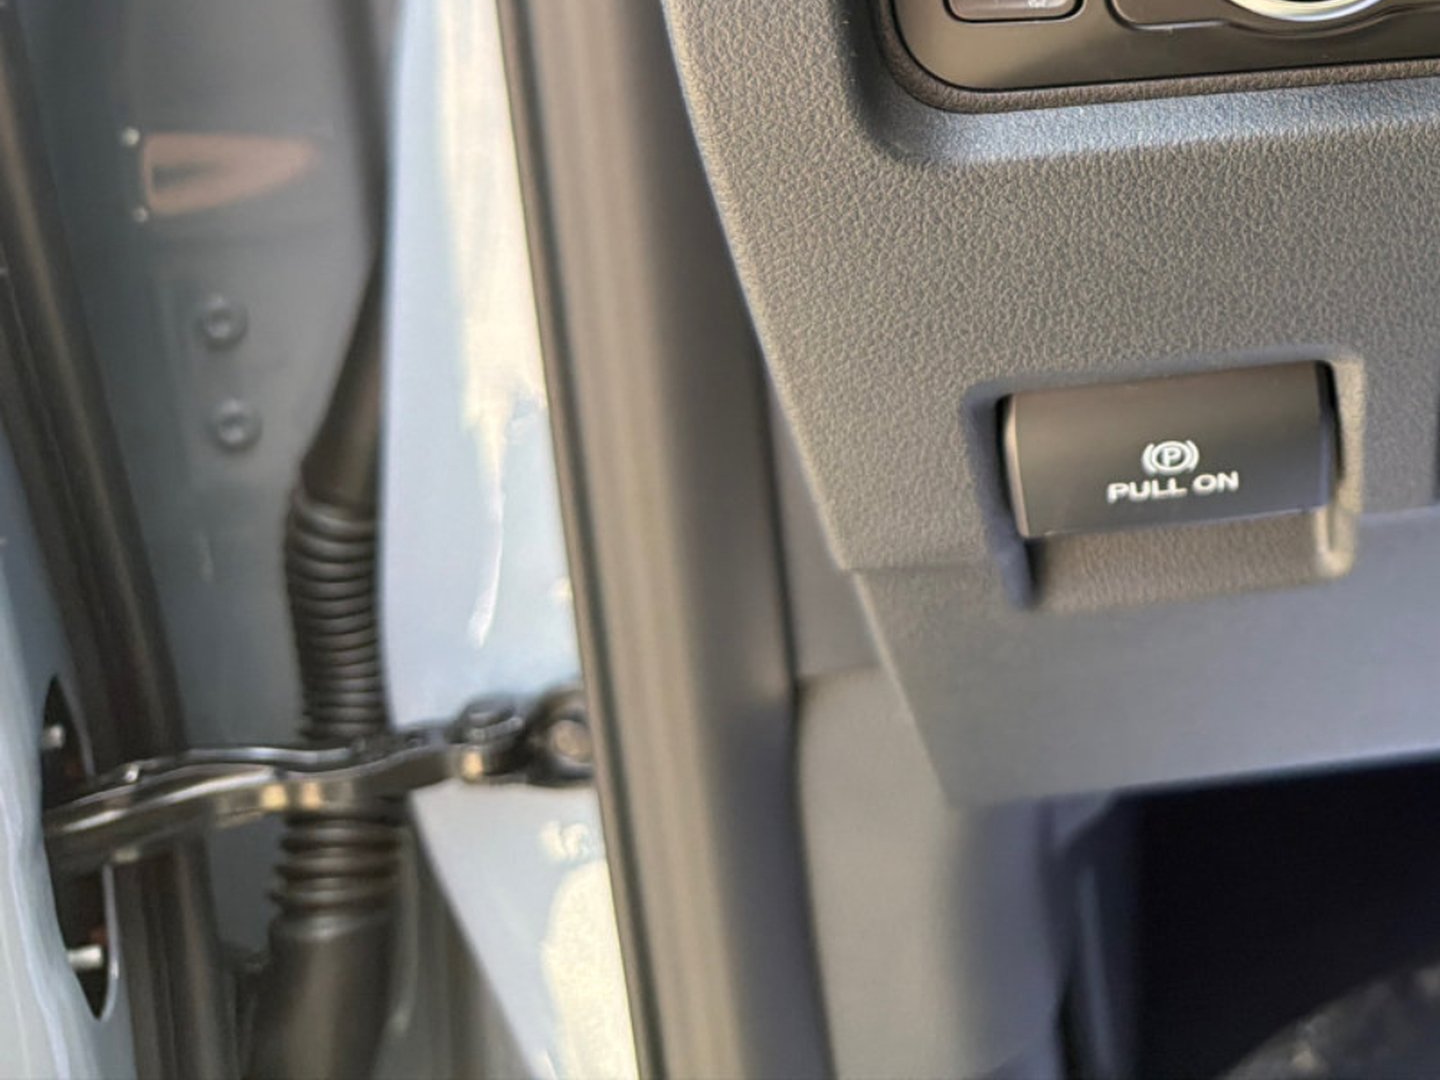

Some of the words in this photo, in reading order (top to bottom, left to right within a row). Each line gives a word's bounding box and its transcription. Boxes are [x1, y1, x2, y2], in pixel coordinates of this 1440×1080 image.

[1160, 446, 1182, 467] P
[1106, 477, 1188, 504] PULL
[1192, 470, 1240, 496] ON
